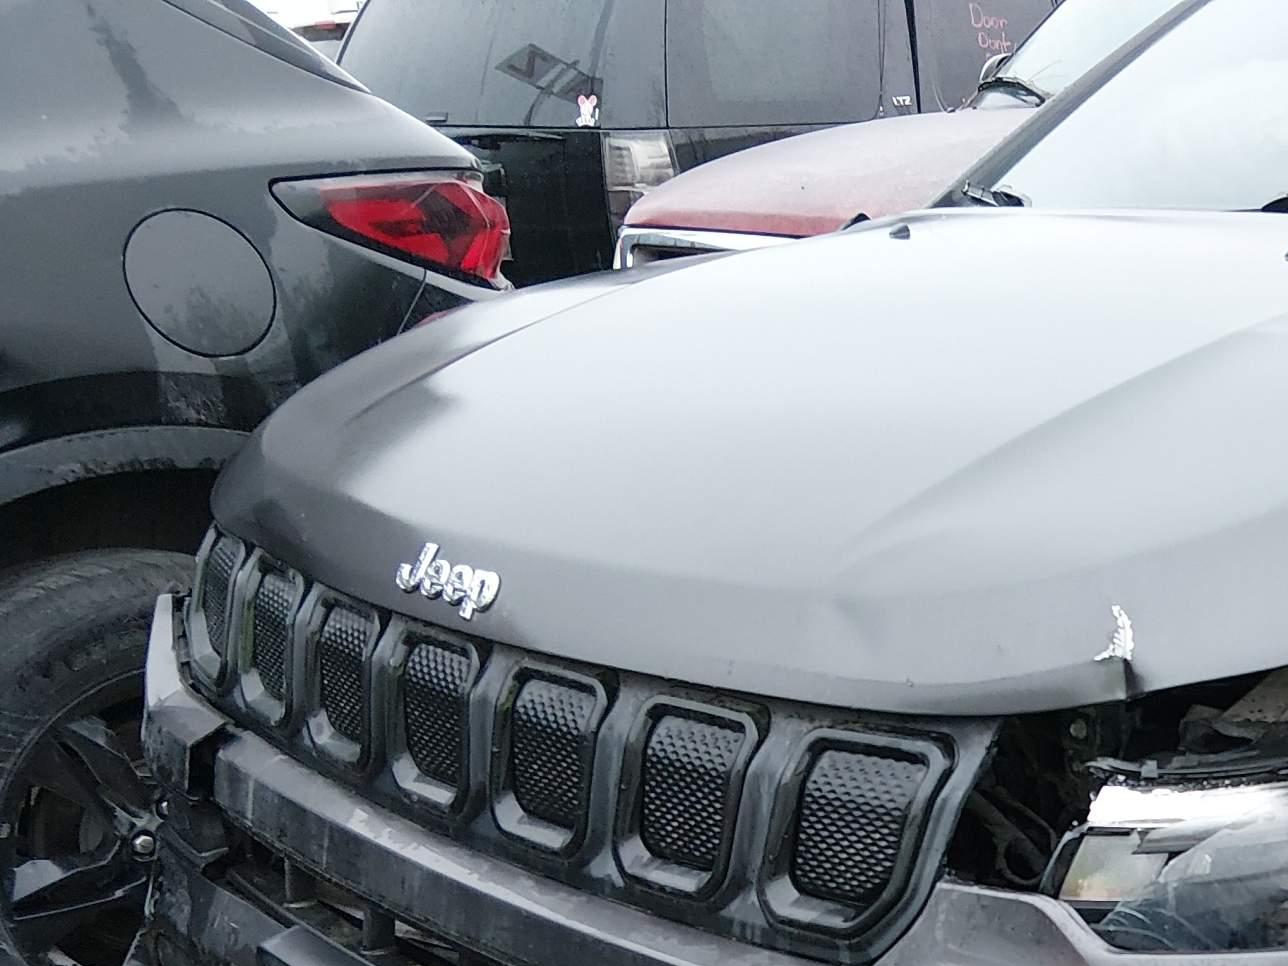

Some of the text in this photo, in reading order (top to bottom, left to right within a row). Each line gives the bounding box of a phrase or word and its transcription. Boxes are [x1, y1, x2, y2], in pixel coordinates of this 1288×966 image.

[969, 3, 1008, 29] Door
[891, 95, 912, 107] LTZ
[396, 542, 501, 621] Jeep
